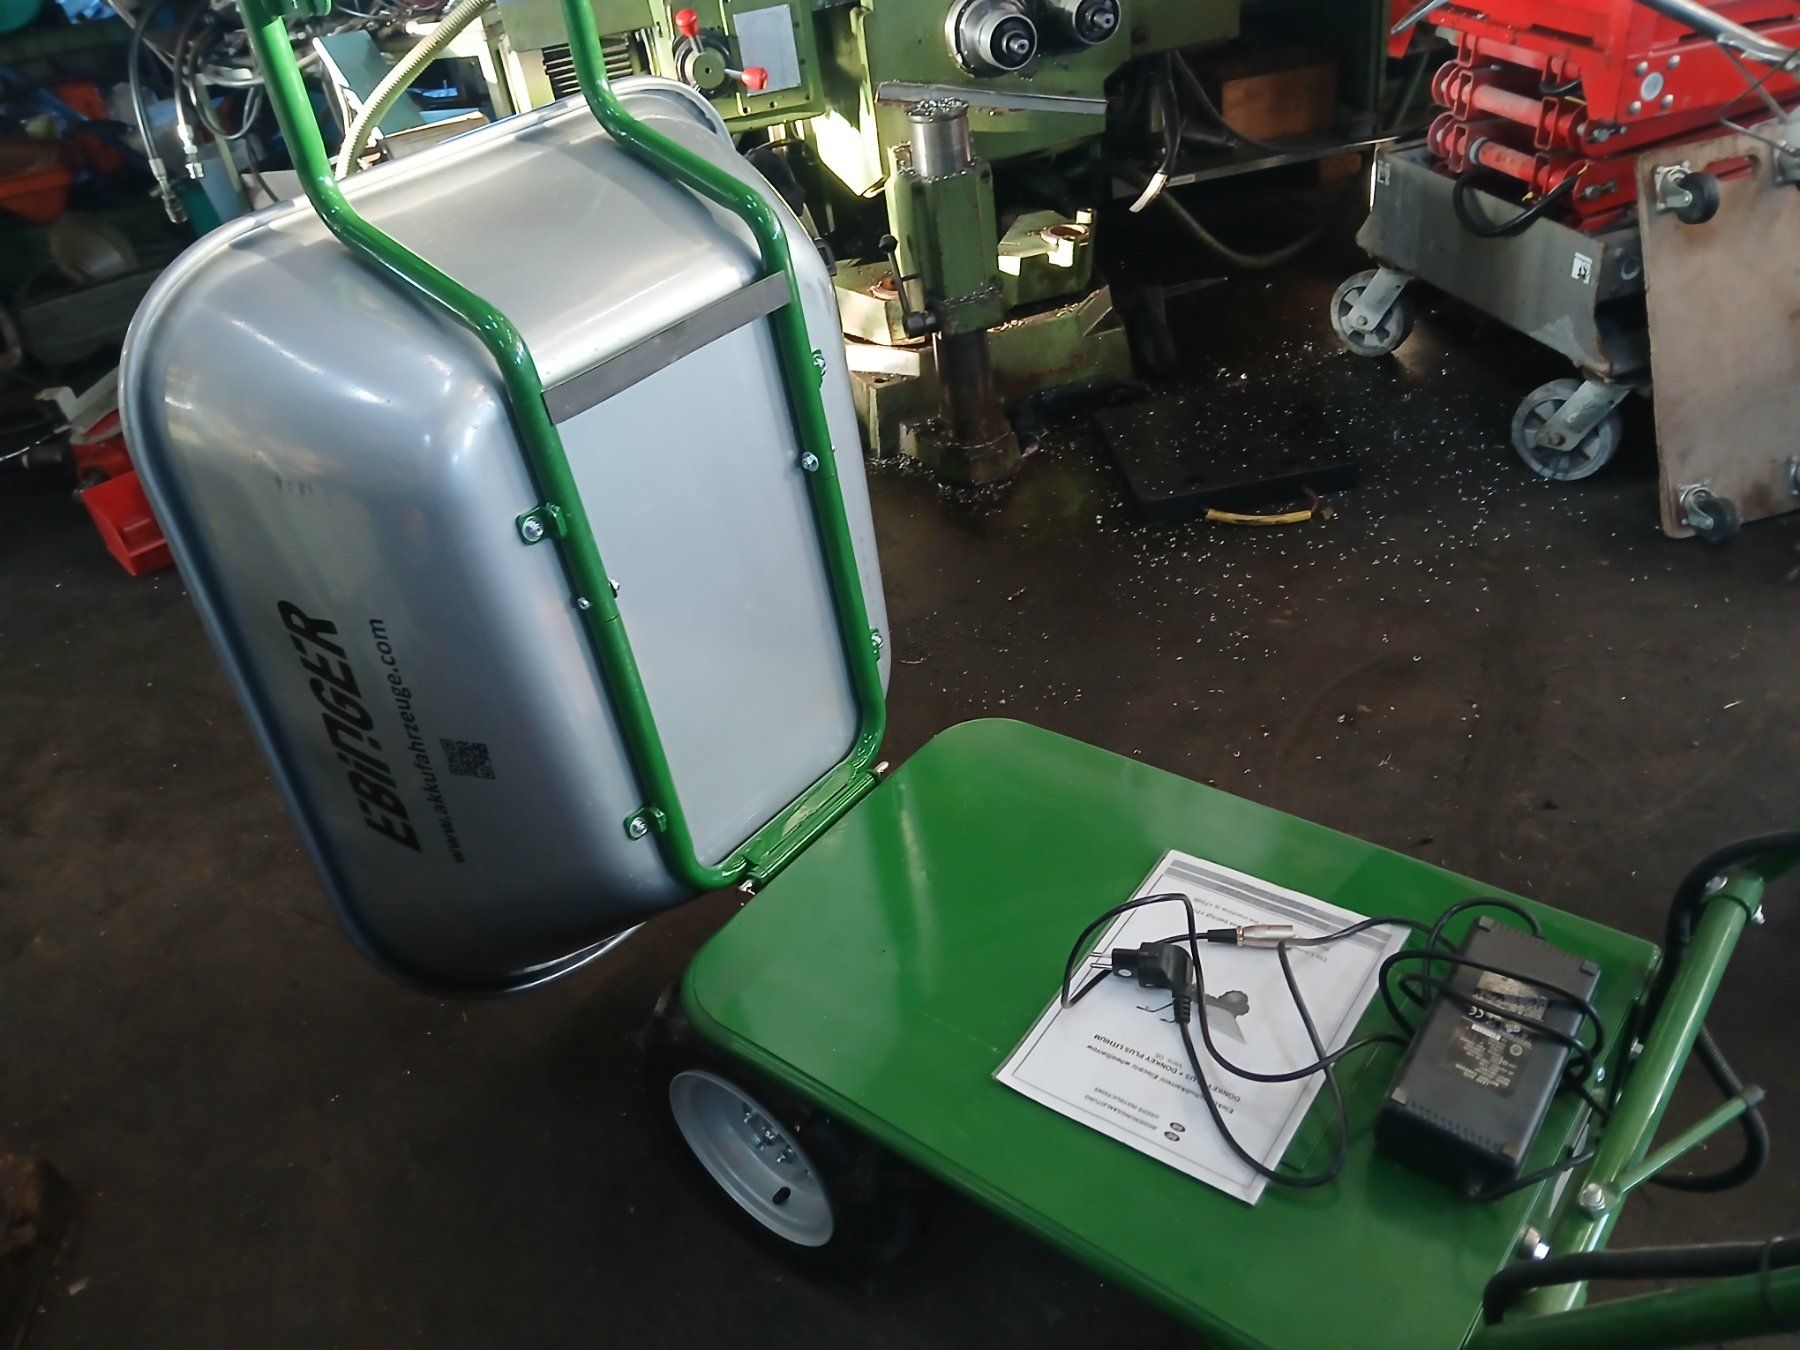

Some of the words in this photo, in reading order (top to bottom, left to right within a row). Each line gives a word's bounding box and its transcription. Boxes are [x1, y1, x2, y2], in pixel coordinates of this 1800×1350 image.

[369, 618, 465, 863] www.akkufahrzeuge.com
[1093, 1033, 1123, 1049] LITHIUM
[1123, 1046, 1144, 1058] PLUS
[1131, 1063, 1158, 1080] Electric
[1145, 1055, 1177, 1074] DONKEY
[1093, 1087, 1137, 1109] INSTRUCTIONS
